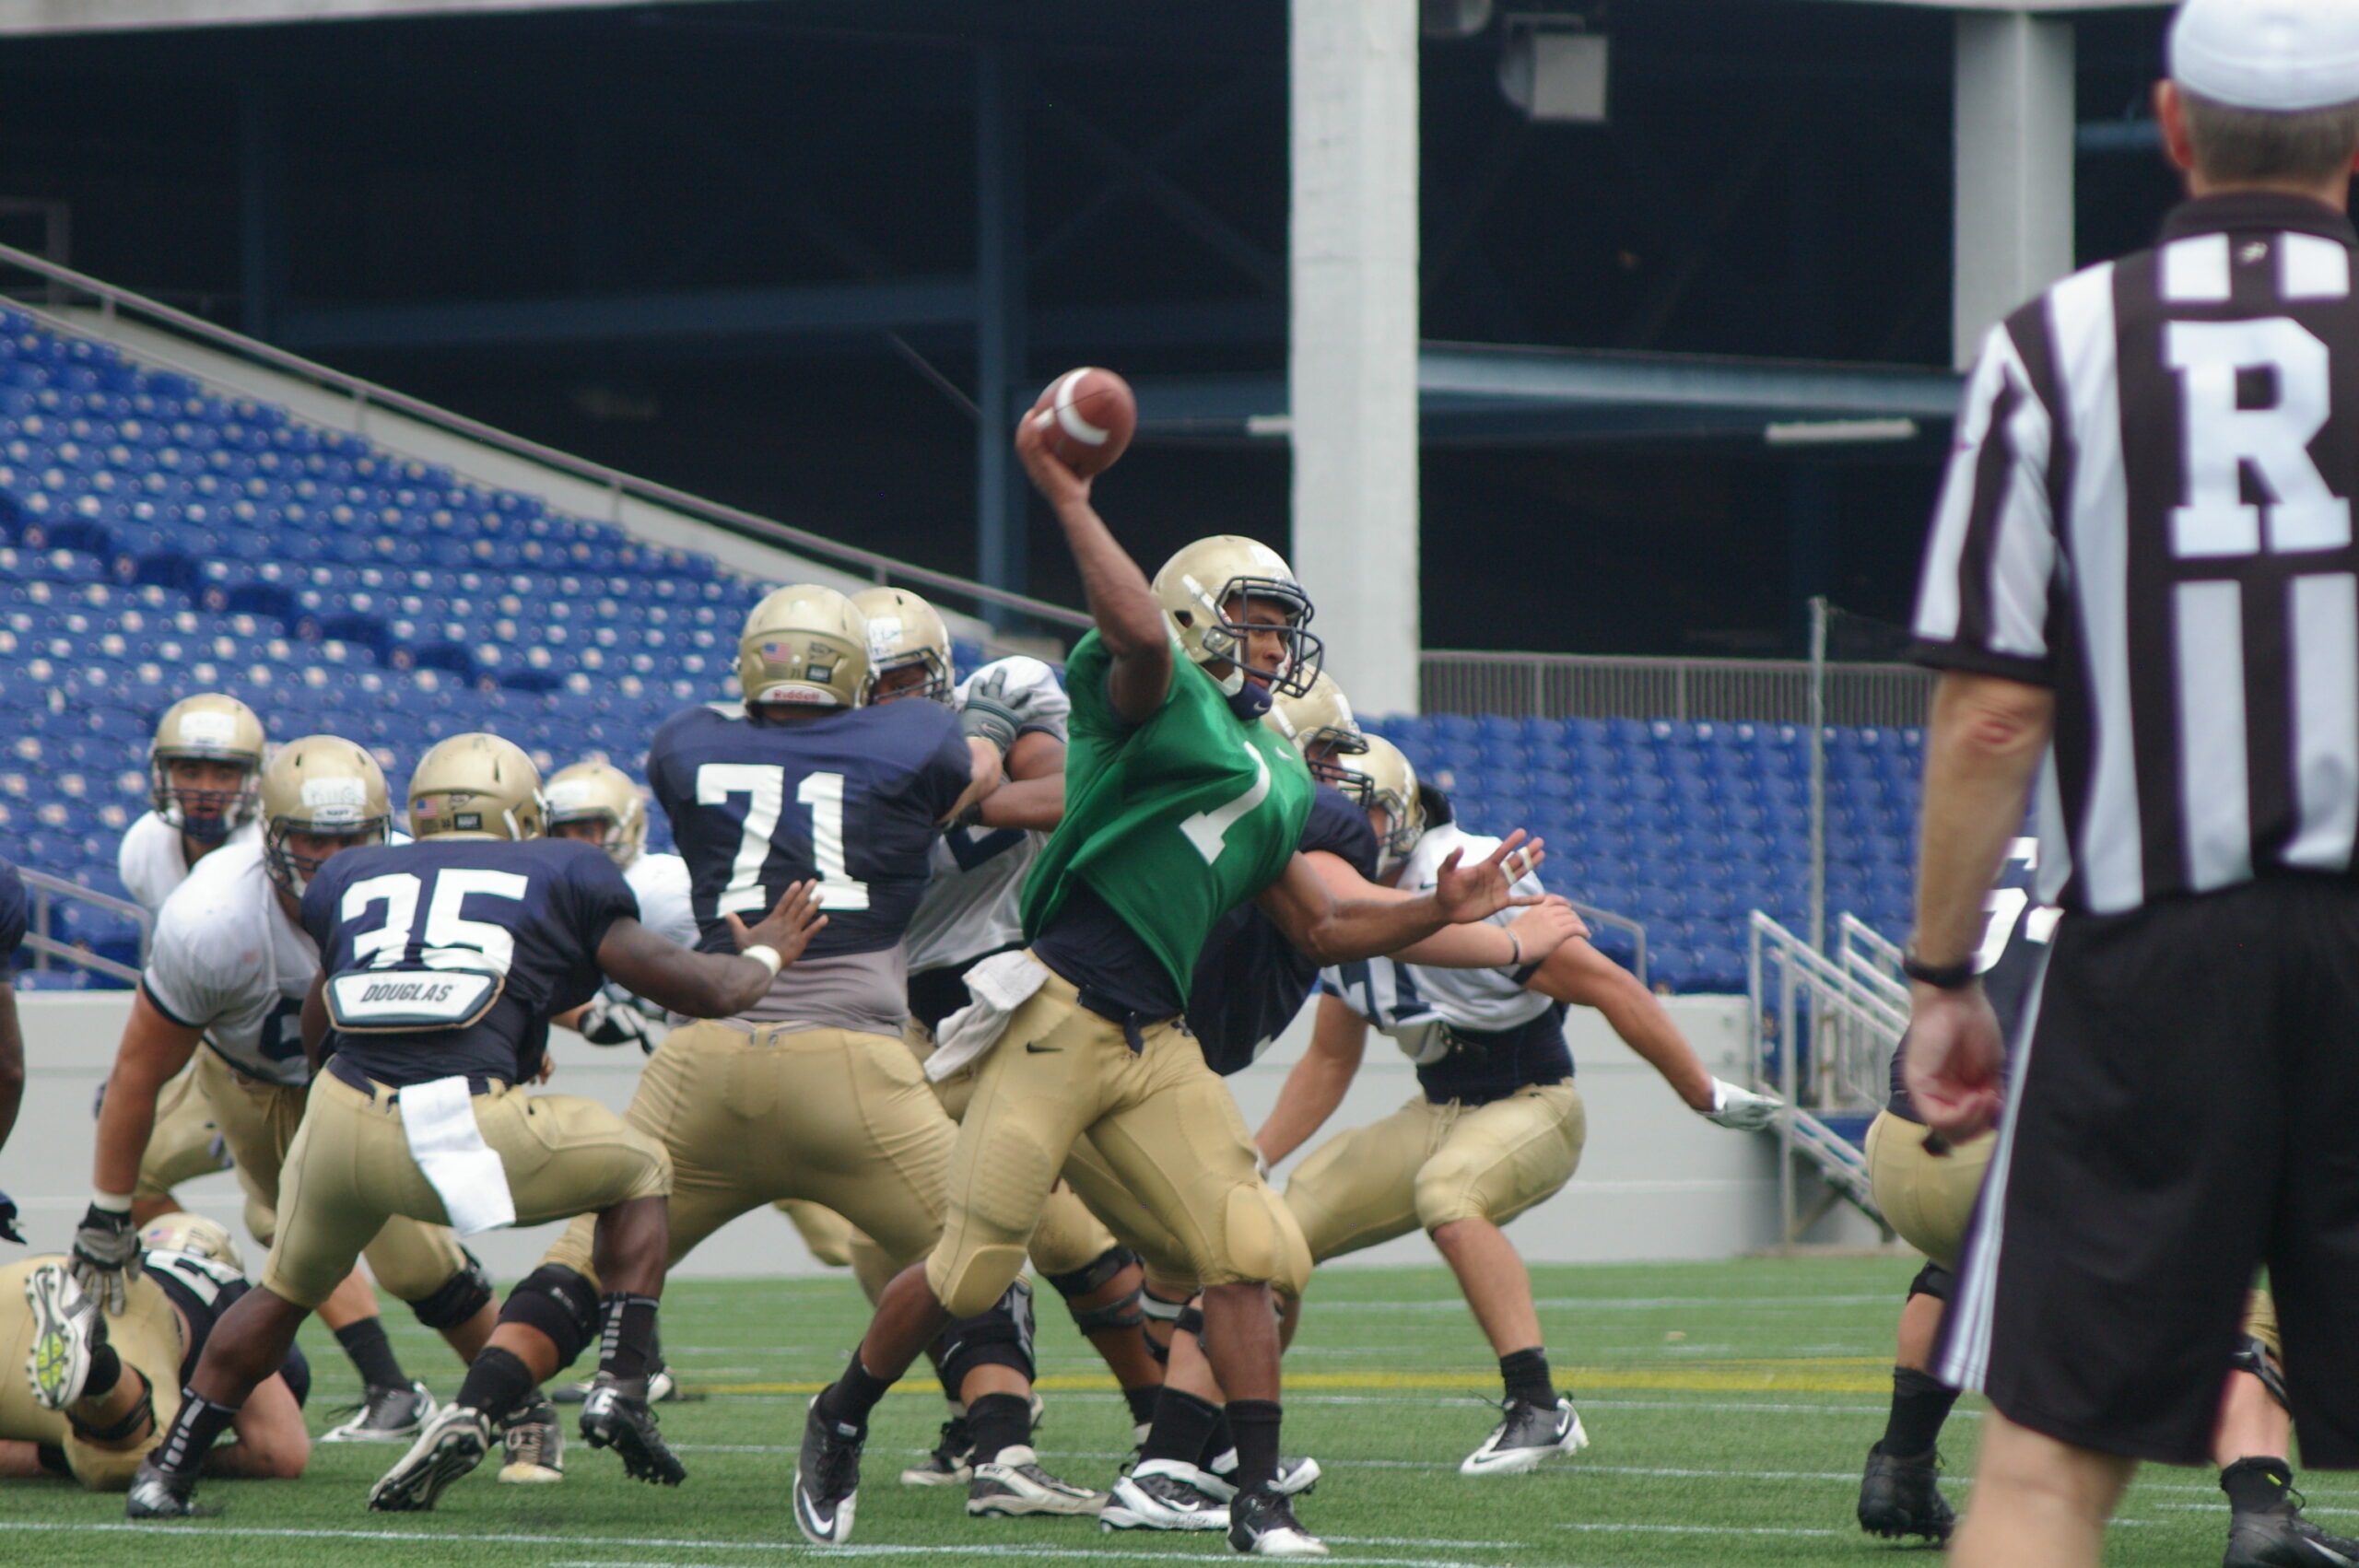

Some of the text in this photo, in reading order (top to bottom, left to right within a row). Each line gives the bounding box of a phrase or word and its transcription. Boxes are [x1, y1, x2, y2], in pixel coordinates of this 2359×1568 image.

[2162, 316, 2352, 558] R
[773, 690, 821, 701] Riddell
[697, 763, 869, 919] 71
[341, 868, 529, 977] 35
[360, 982, 454, 1003] DOUGLAS
